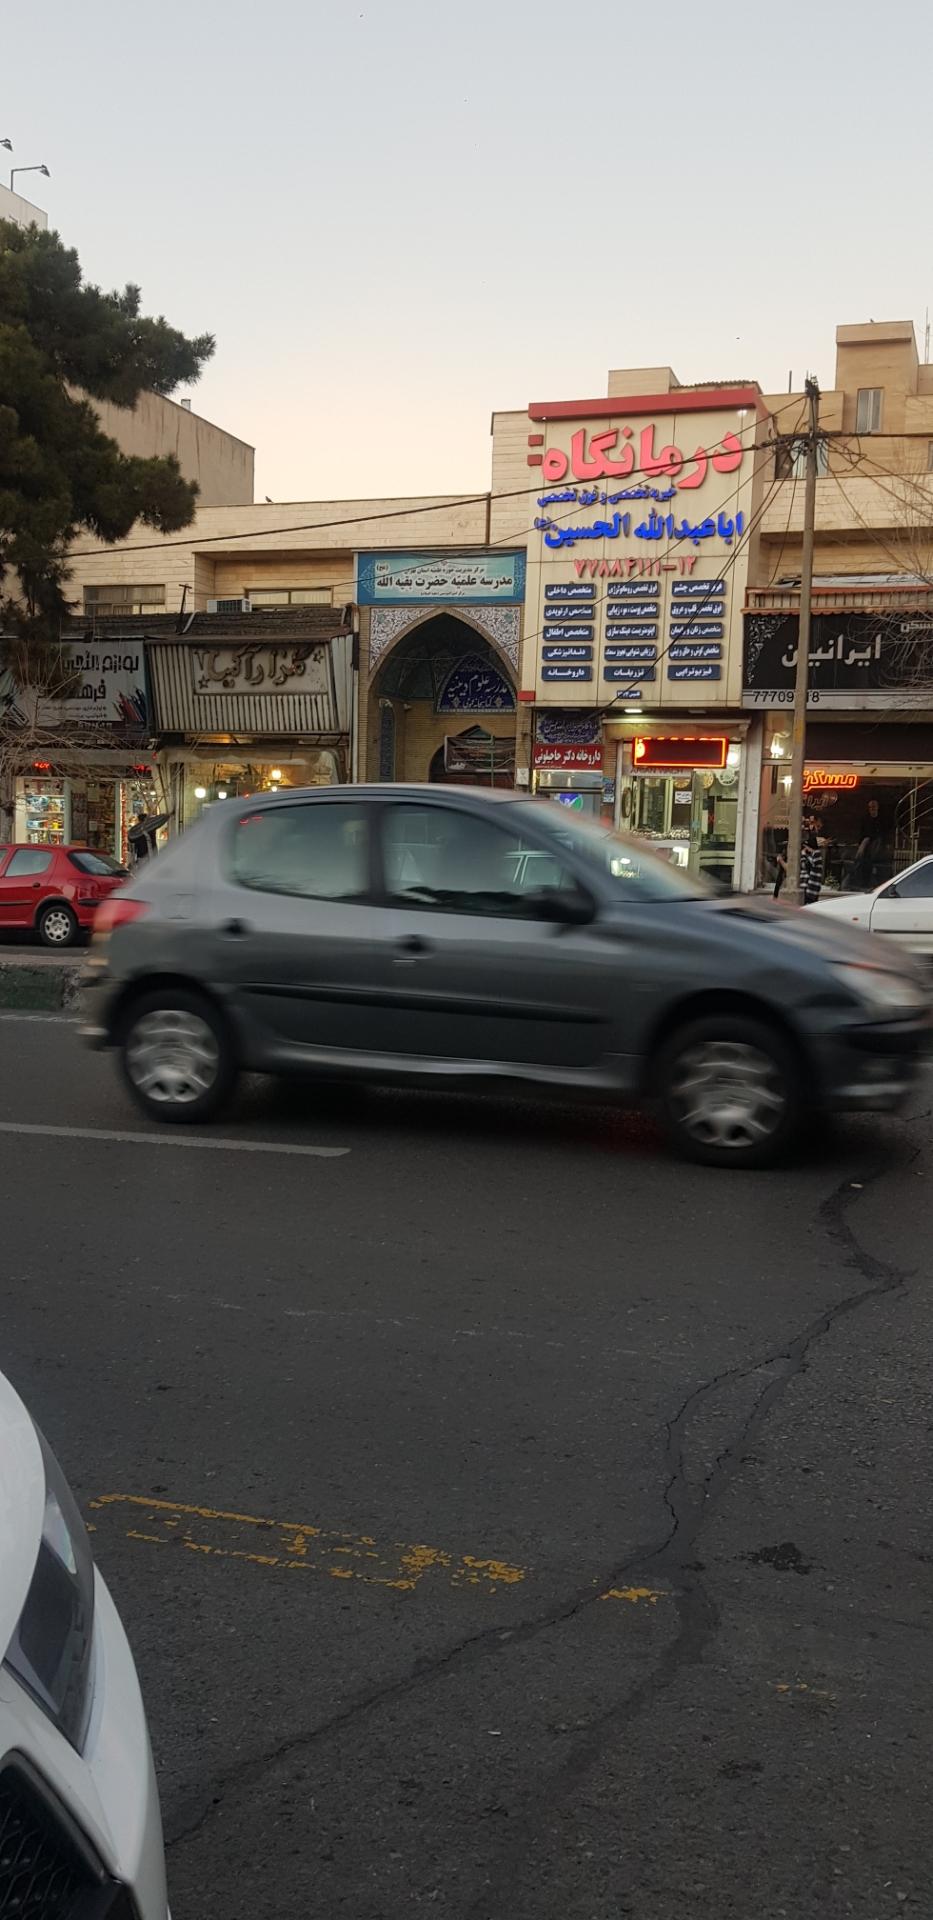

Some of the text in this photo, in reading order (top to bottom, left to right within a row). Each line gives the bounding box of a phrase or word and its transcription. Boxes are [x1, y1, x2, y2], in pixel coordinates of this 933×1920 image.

[542, 424, 743, 488] درمانگاه
[537, 487, 577, 507] تخصصی
[544, 511, 631, 548] الحسین
[415, 575, 448, 590] حضرت
[480, 575, 513, 589] مدرسه
[547, 586, 592, 596] متخصص داخلی
[547, 668, 585, 678] داروخانه
[576, 749, 601, 765] داروخانه
